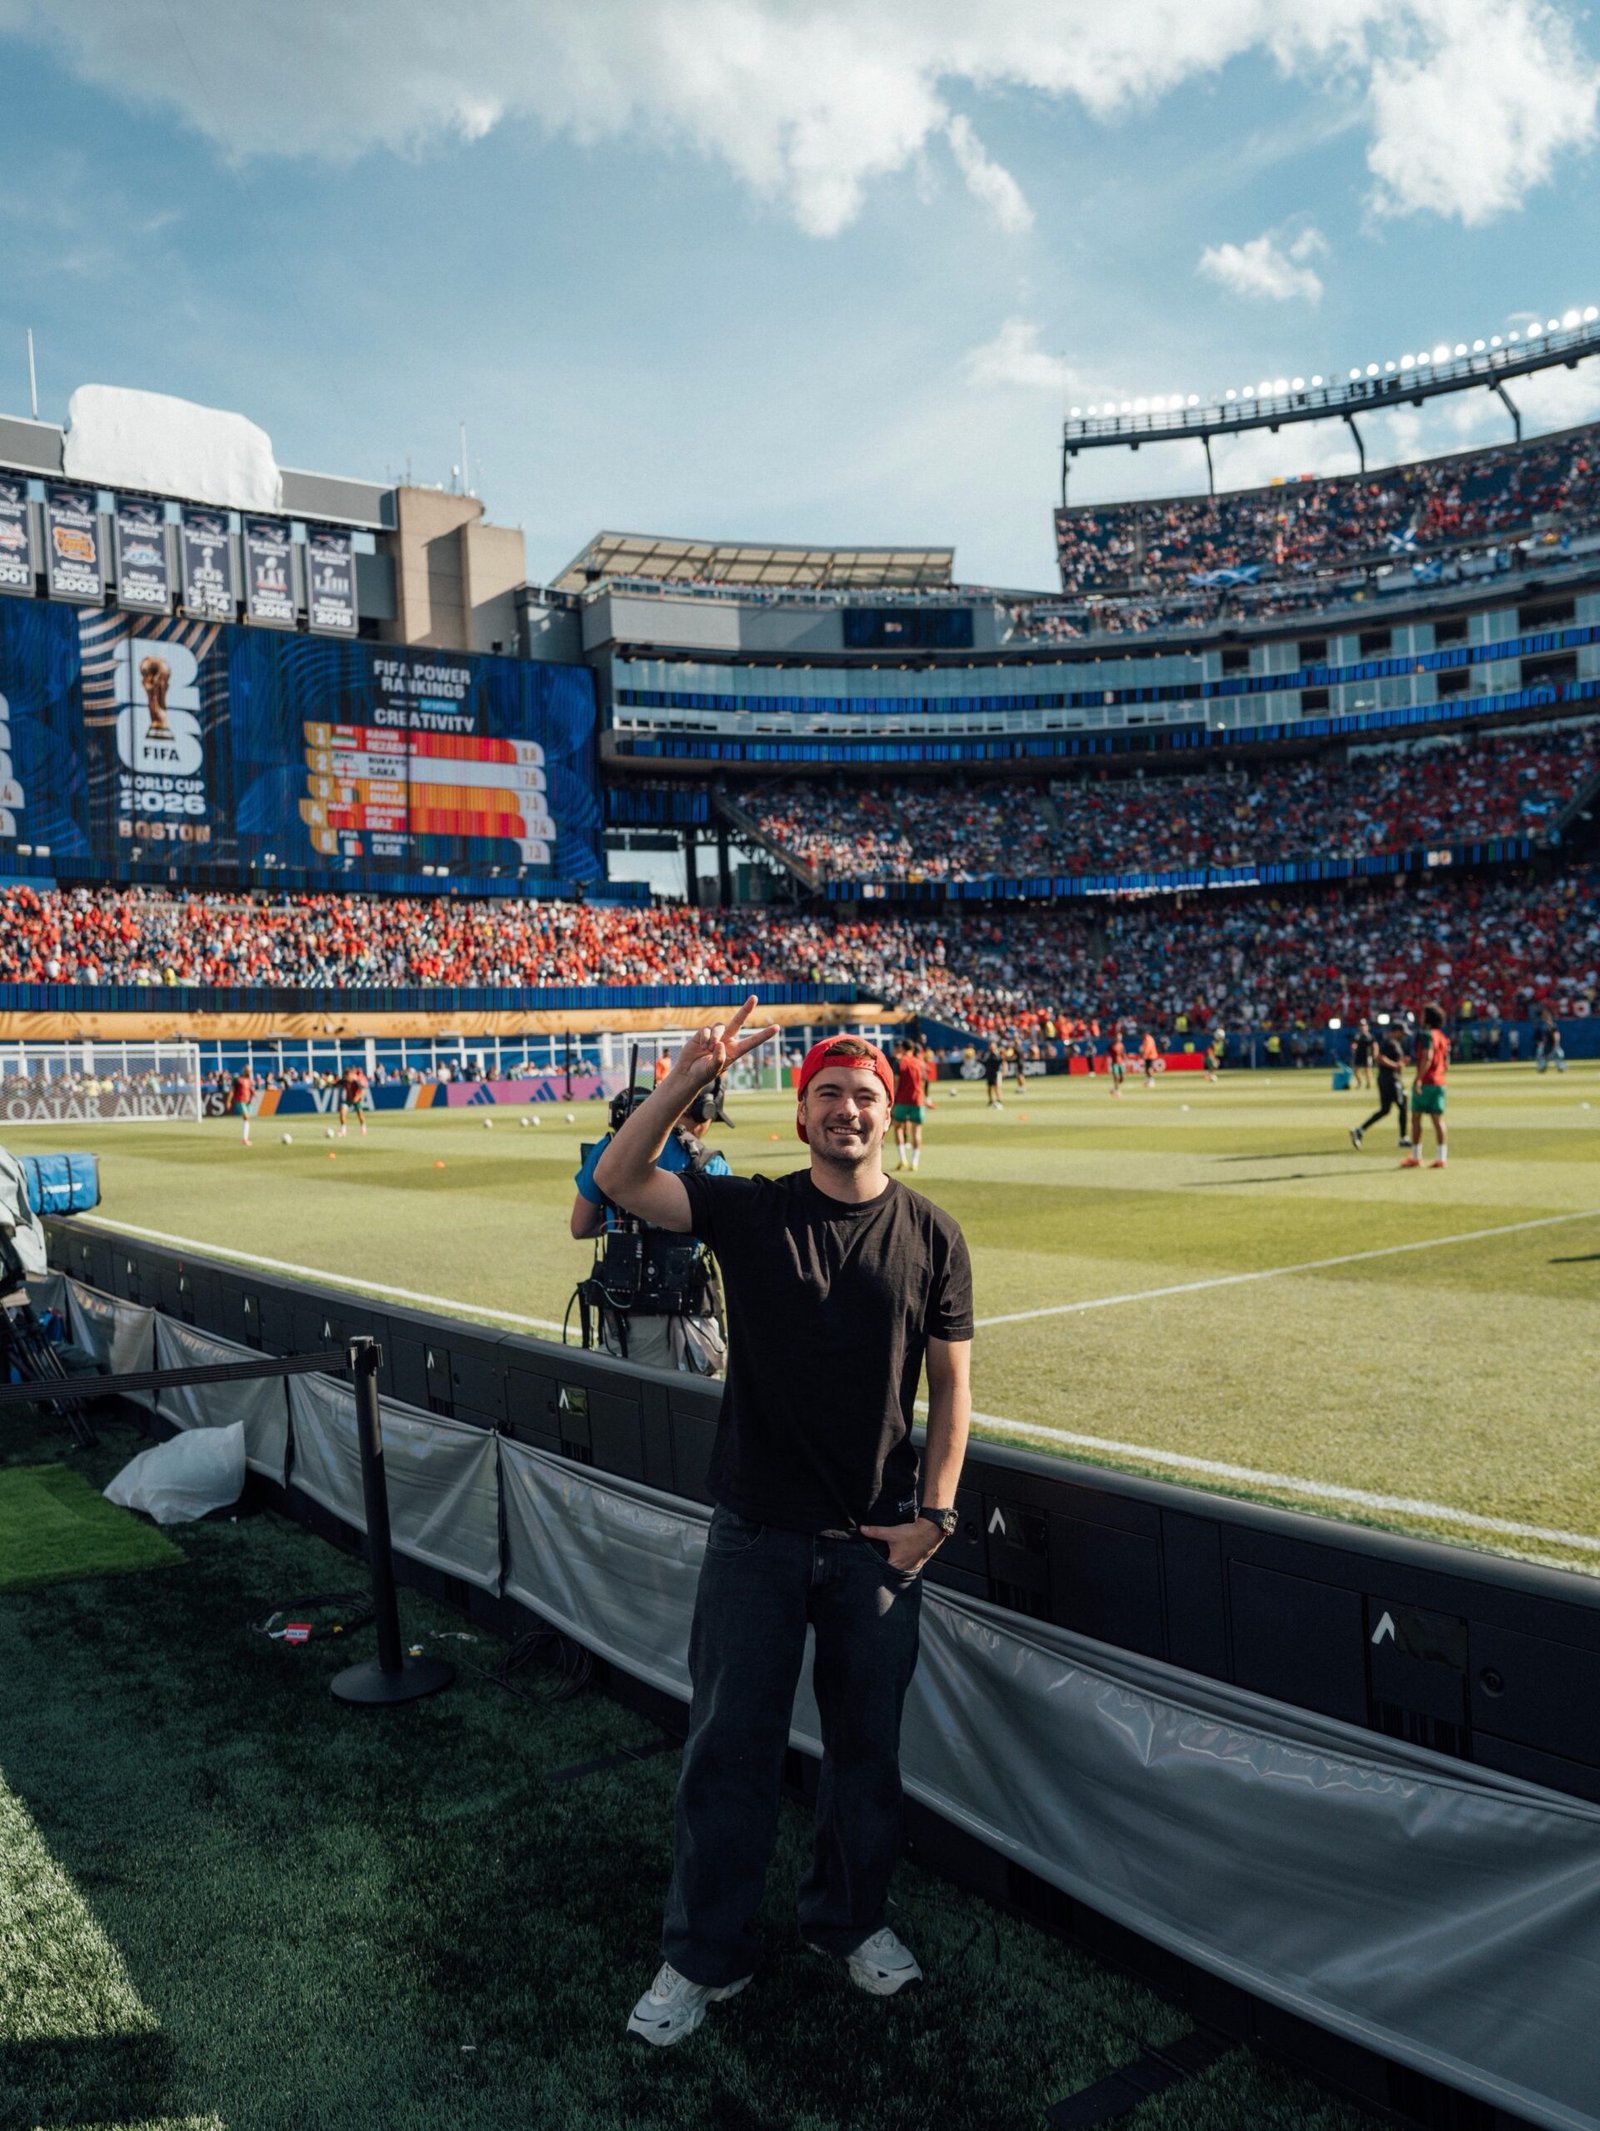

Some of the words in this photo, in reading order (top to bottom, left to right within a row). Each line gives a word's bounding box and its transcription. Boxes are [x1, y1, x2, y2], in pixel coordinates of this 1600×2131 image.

[54, 576, 99, 594] 2003
[123, 587, 166, 603] 2004
[254, 604, 292, 620] 2016
[373, 660, 411, 678] FIFA
[413, 664, 471, 685] POWER
[381, 676, 465, 700] RANKINGS
[374, 708, 475, 733] CREATIVITY
[144, 746, 179, 762] FIFA
[120, 774, 174, 792] WORLD
[175, 778, 205, 794] CUP
[120, 789, 206, 816] 2026
[118, 820, 211, 844] BOSTON
[7, 1098, 101, 1121] QATAR
[115, 1092, 226, 1118] AIRWAYS
[306, 1087, 376, 1112] VIA
